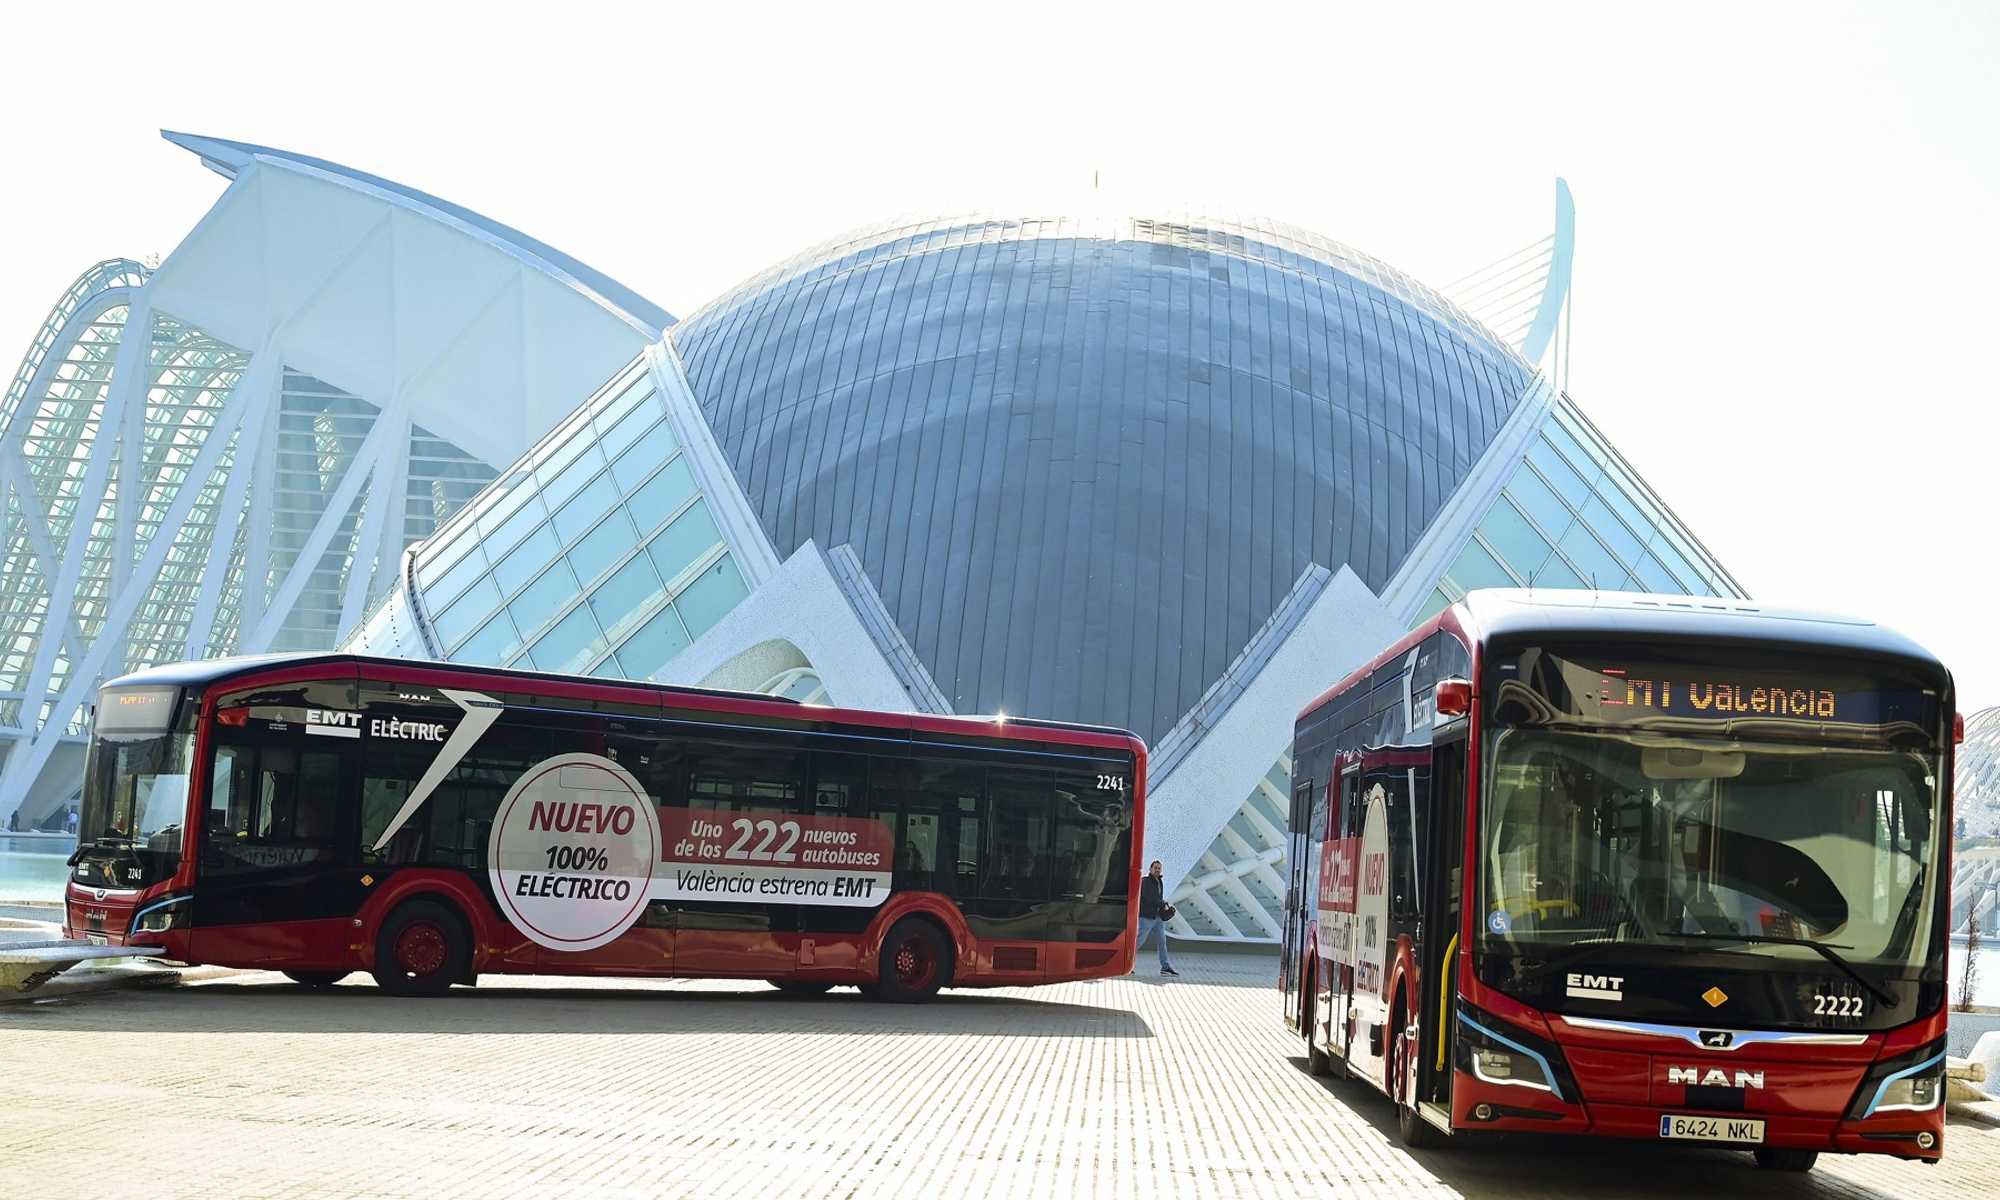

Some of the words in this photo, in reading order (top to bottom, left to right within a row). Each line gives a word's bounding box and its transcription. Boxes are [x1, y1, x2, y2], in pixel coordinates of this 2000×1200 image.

[306, 709, 363, 727] EMT
[370, 716, 444, 742] ELÈCTRIC
[1096, 774, 1124, 791] 2241
[528, 800, 635, 836] NUEVO
[691, 820, 723, 838] Uno
[674, 838, 694, 857] de
[697, 840, 722, 859] los
[724, 818, 801, 862] 222
[803, 829, 857, 846] nuevos
[545, 845, 608, 871] 100%
[802, 847, 880, 866] autobuses
[516, 872, 632, 902] ELÉCTRICO
[676, 869, 754, 894] València
[759, 878, 828, 897] estrena
[832, 876, 877, 899] EMT
[1566, 973, 1624, 990] EMT
[1814, 994, 1863, 1017] 2222
[1667, 1066, 1764, 1090] MAN
[1675, 1119, 1719, 1137] 6424
[1727, 1122, 1760, 1140] NKL
